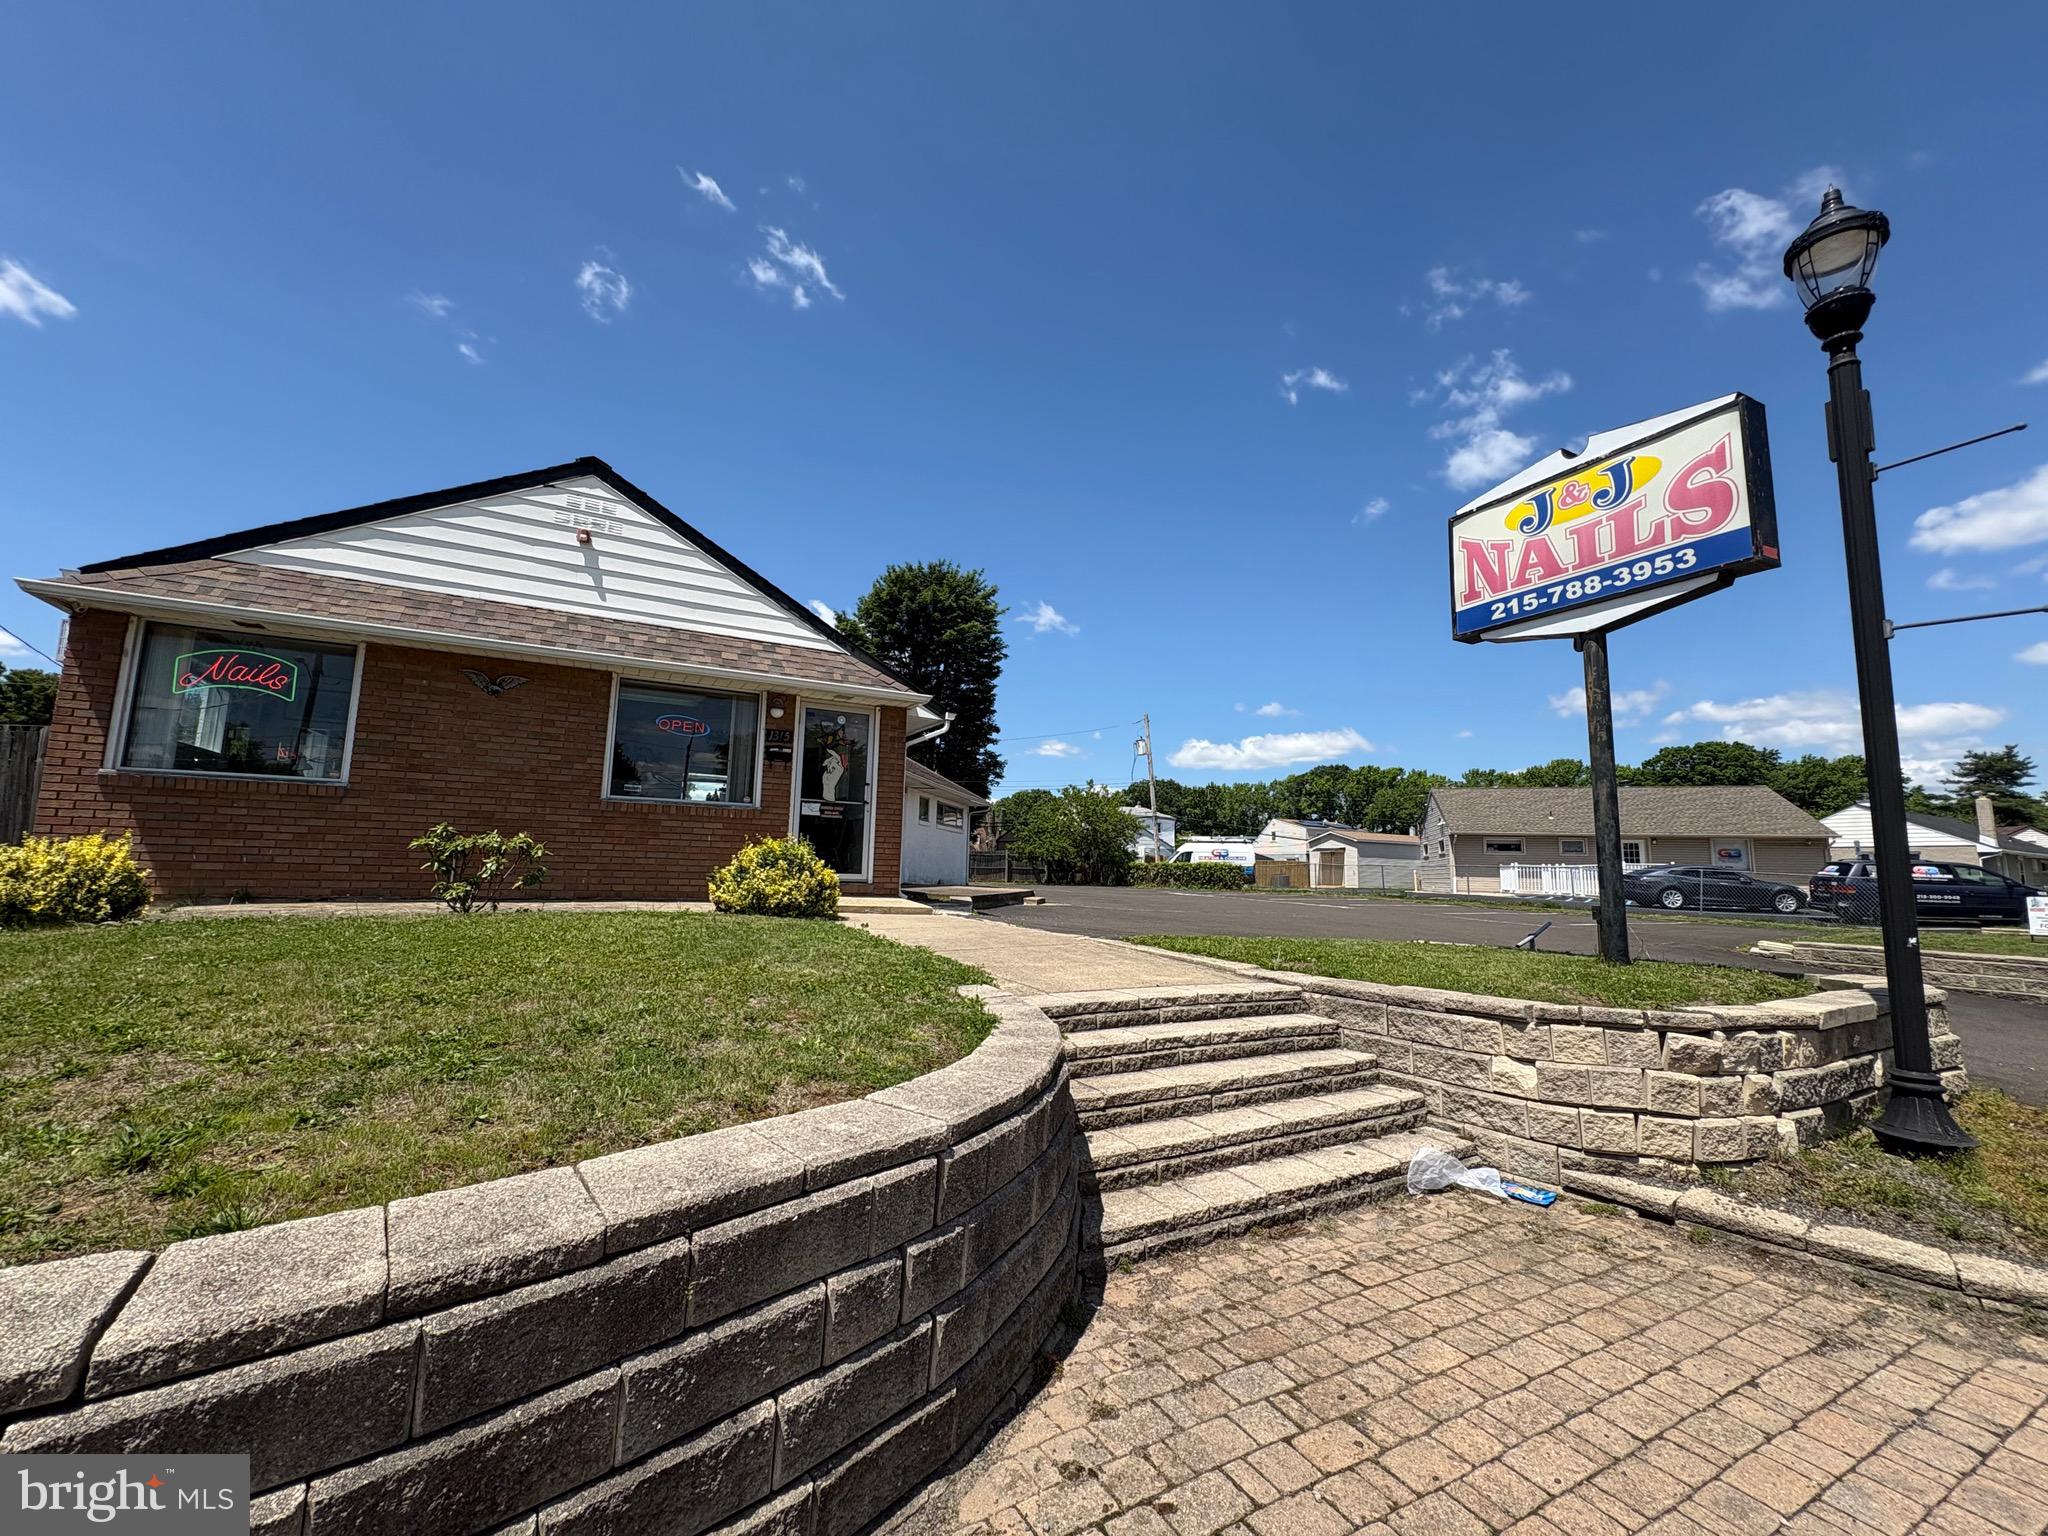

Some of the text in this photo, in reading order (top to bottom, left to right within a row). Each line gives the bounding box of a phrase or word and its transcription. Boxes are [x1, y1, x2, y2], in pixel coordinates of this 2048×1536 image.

[1459, 432, 1740, 606] NAILS
[1490, 548, 1697, 621] 215-788-3953
[179, 654, 289, 690] Nails
[658, 719, 705, 734] OPEN
